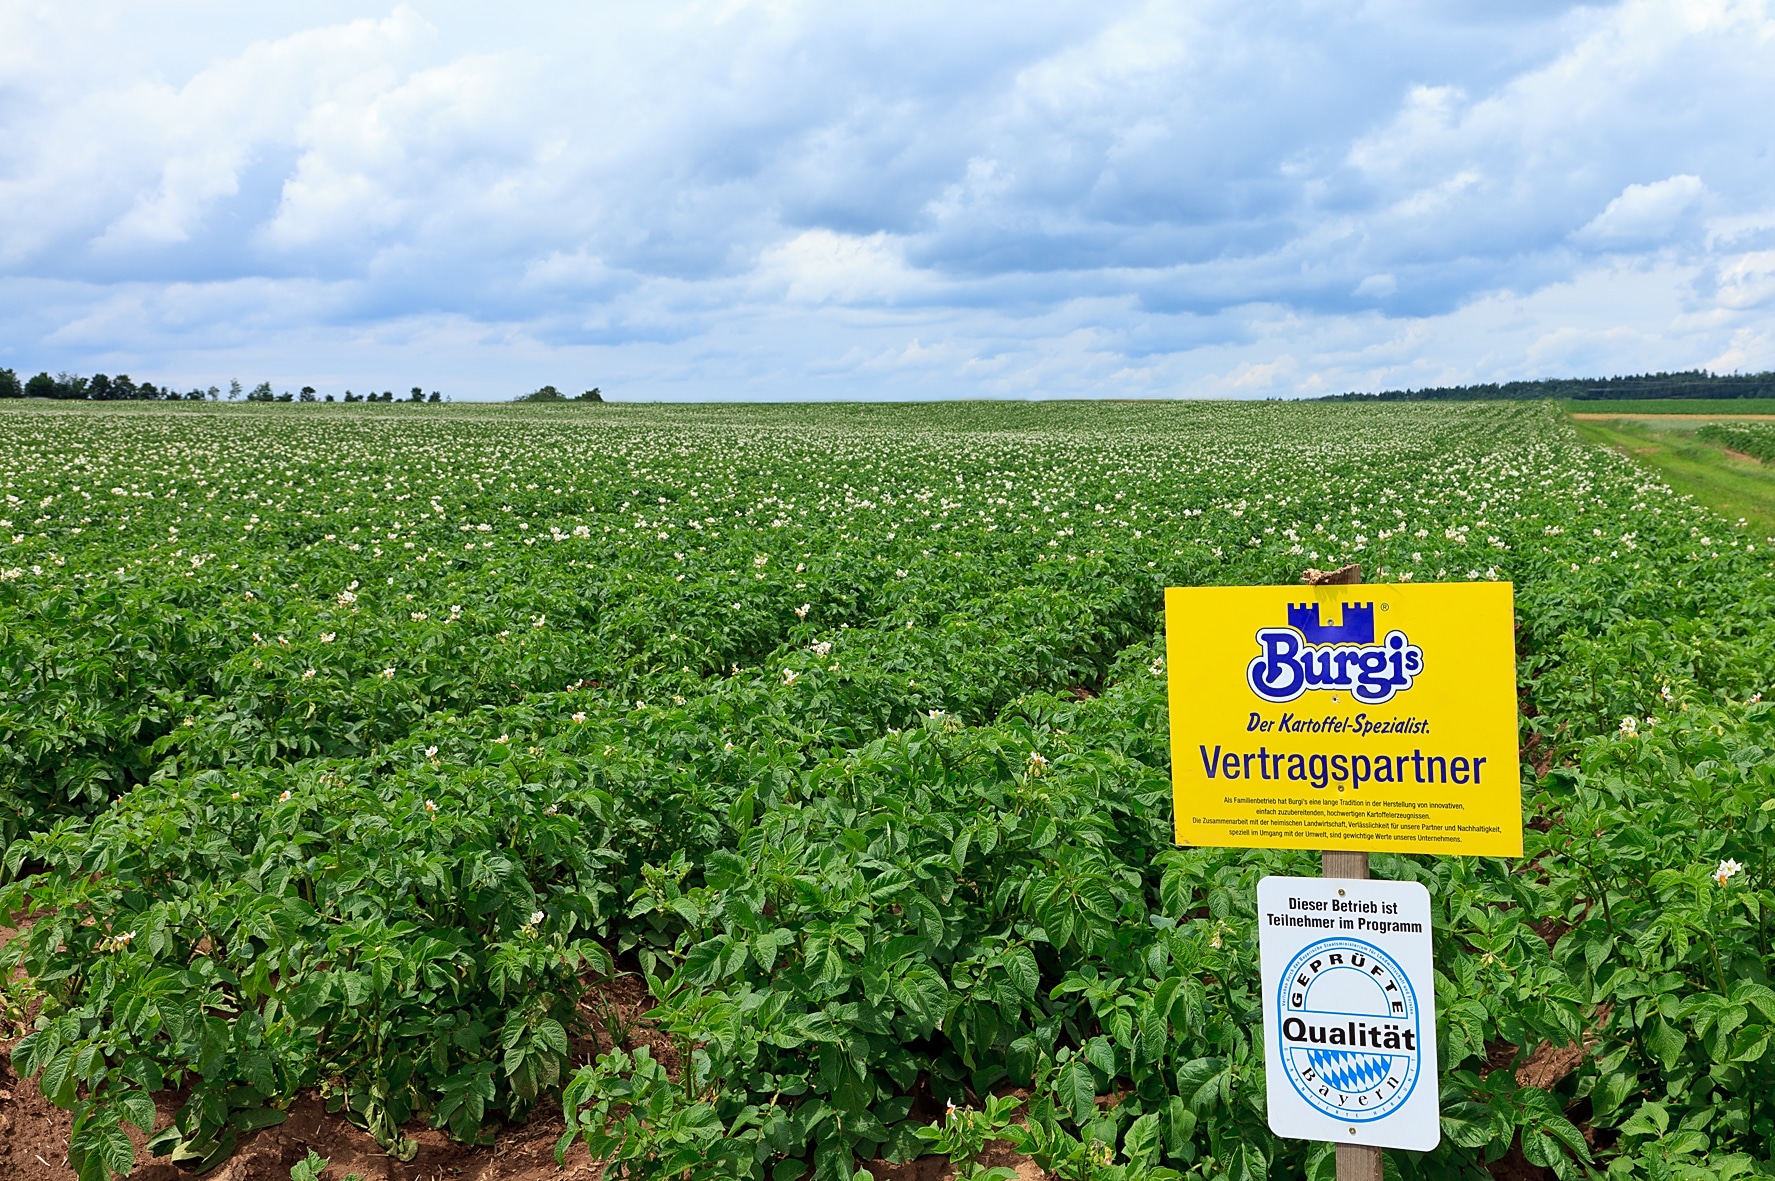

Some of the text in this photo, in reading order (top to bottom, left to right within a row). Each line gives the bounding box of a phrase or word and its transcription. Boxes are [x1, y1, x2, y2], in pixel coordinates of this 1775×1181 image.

[1247, 712, 1430, 738] Der Kartoffel-Spezialist.
[1199, 744, 1487, 789] Vertragspartner
[1288, 798, 1308, 806] Burgi's
[1383, 801, 1416, 810] Herstellung
[1429, 802, 1465, 810] innovativen,
[1327, 810, 1366, 819] hochwertigen
[1367, 811, 1431, 820] Kartoffelerzeugnissen.
[1260, 830, 1283, 838] Umgang
[1418, 835, 1462, 843] Unternehmens.
[1304, 820, 1348, 828] Landwirtschaft,
[1348, 821, 1390, 829] Verlässlichkeit
[1457, 825, 1502, 834] Nachhaltigkeit,
[1289, 898, 1398, 915] Dieser Betrieb ist
[1267, 913, 1422, 934] Teilnehmer im Programm
[1291, 952, 1404, 1013] GEPRÜFTE
[1283, 1018, 1416, 1050] Qualität
[1301, 1067, 1400, 1107] Bayern
